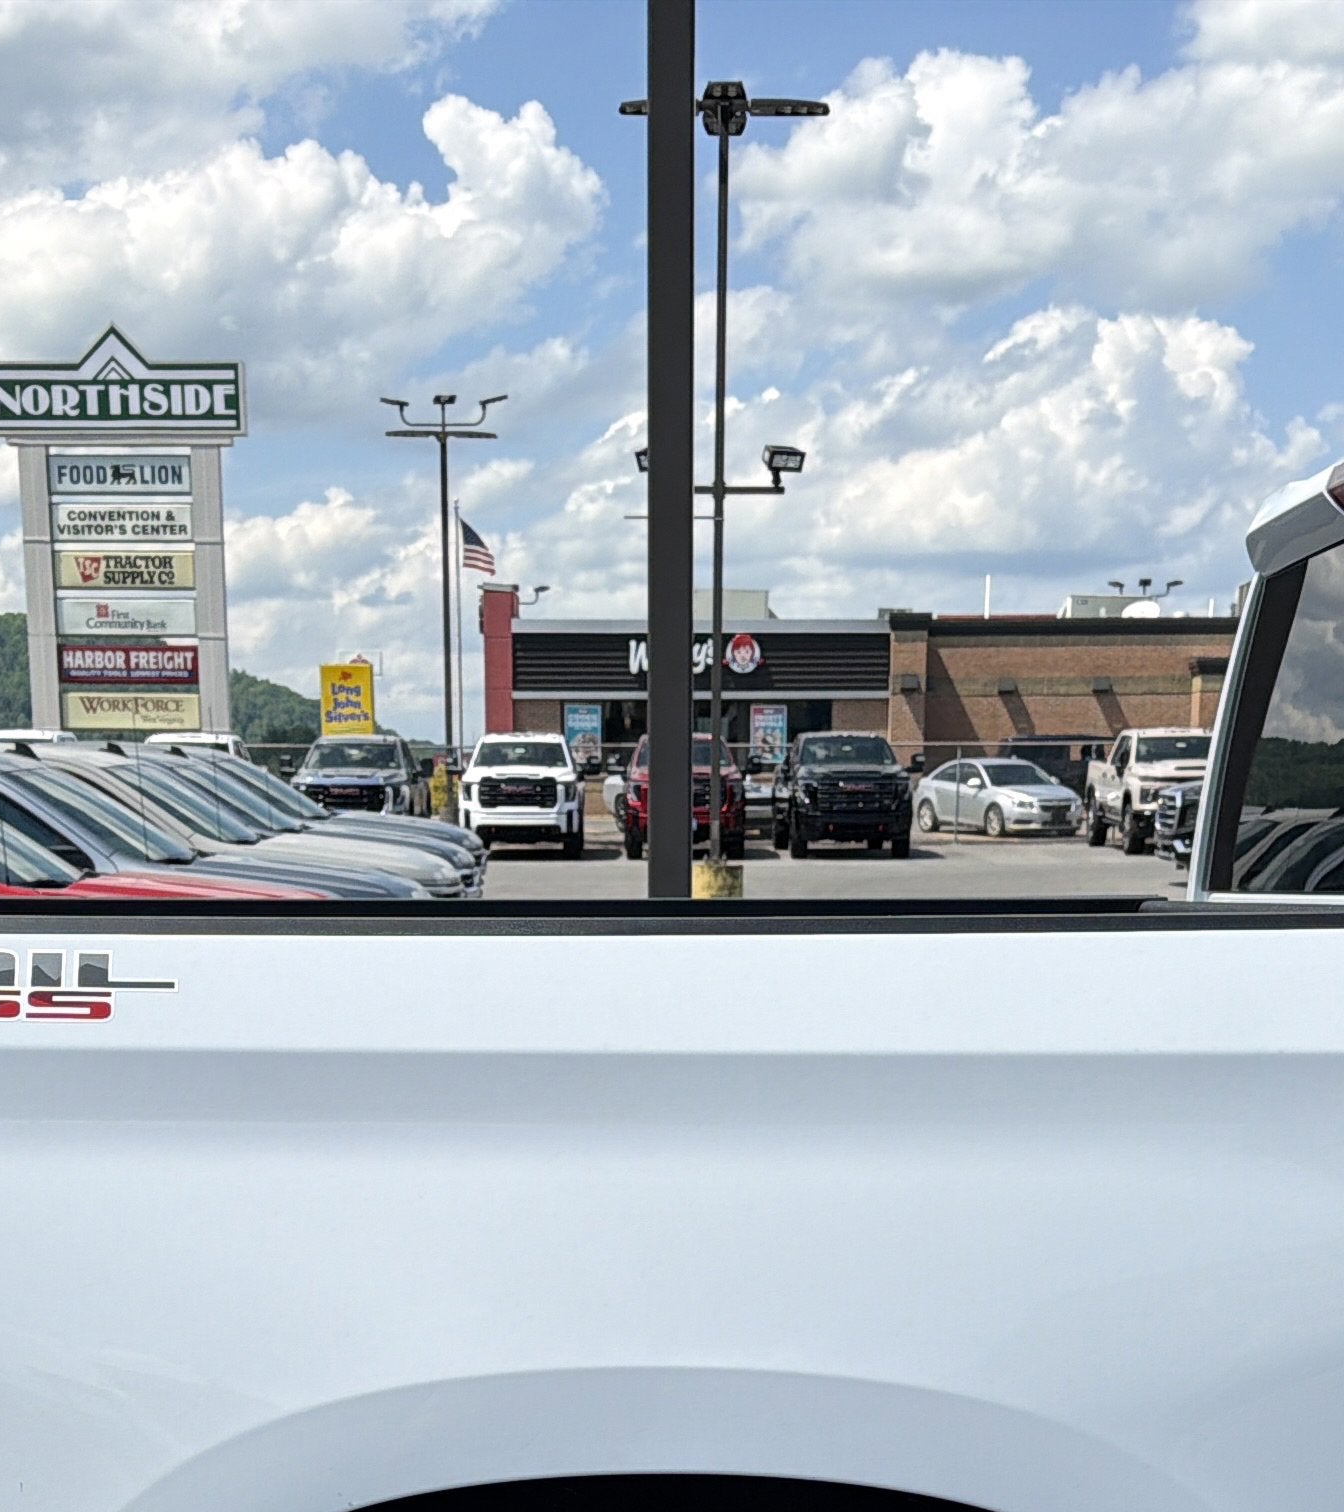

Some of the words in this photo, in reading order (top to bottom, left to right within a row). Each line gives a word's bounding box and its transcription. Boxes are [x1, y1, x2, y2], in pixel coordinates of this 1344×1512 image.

[57, 464, 108, 485] FOOD
[140, 464, 183, 485] LION
[66, 509, 161, 522] CONVENTION
[165, 510, 175, 521] &
[56, 523, 127, 536] VISITOR'S
[131, 523, 188, 536] CENTER
[102, 555, 174, 570] TRACTOR
[103, 570, 156, 585] SUPPLY
[85, 617, 144, 630] Community
[63, 650, 127, 669] HARBOR
[130, 651, 194, 670] FREIGHT
